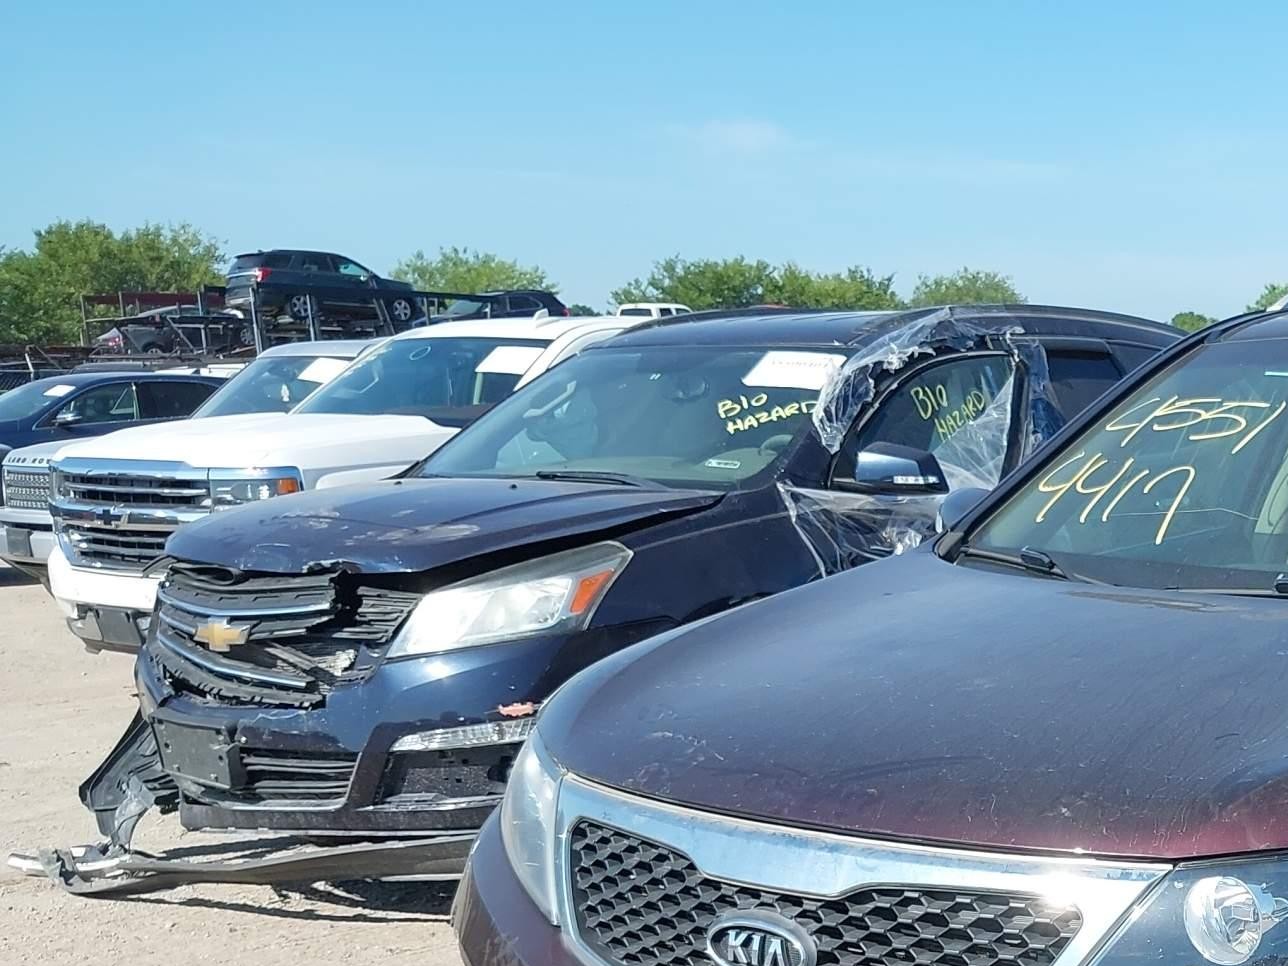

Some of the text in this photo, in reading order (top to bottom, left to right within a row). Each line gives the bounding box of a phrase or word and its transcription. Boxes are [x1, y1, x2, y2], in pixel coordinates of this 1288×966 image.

[716, 392, 769, 419] BIO
[725, 399, 820, 436] HAZARD
[933, 389, 986, 442] HAZARD
[1104, 394, 1287, 455] 4551
[1036, 449, 1196, 546] 4417
